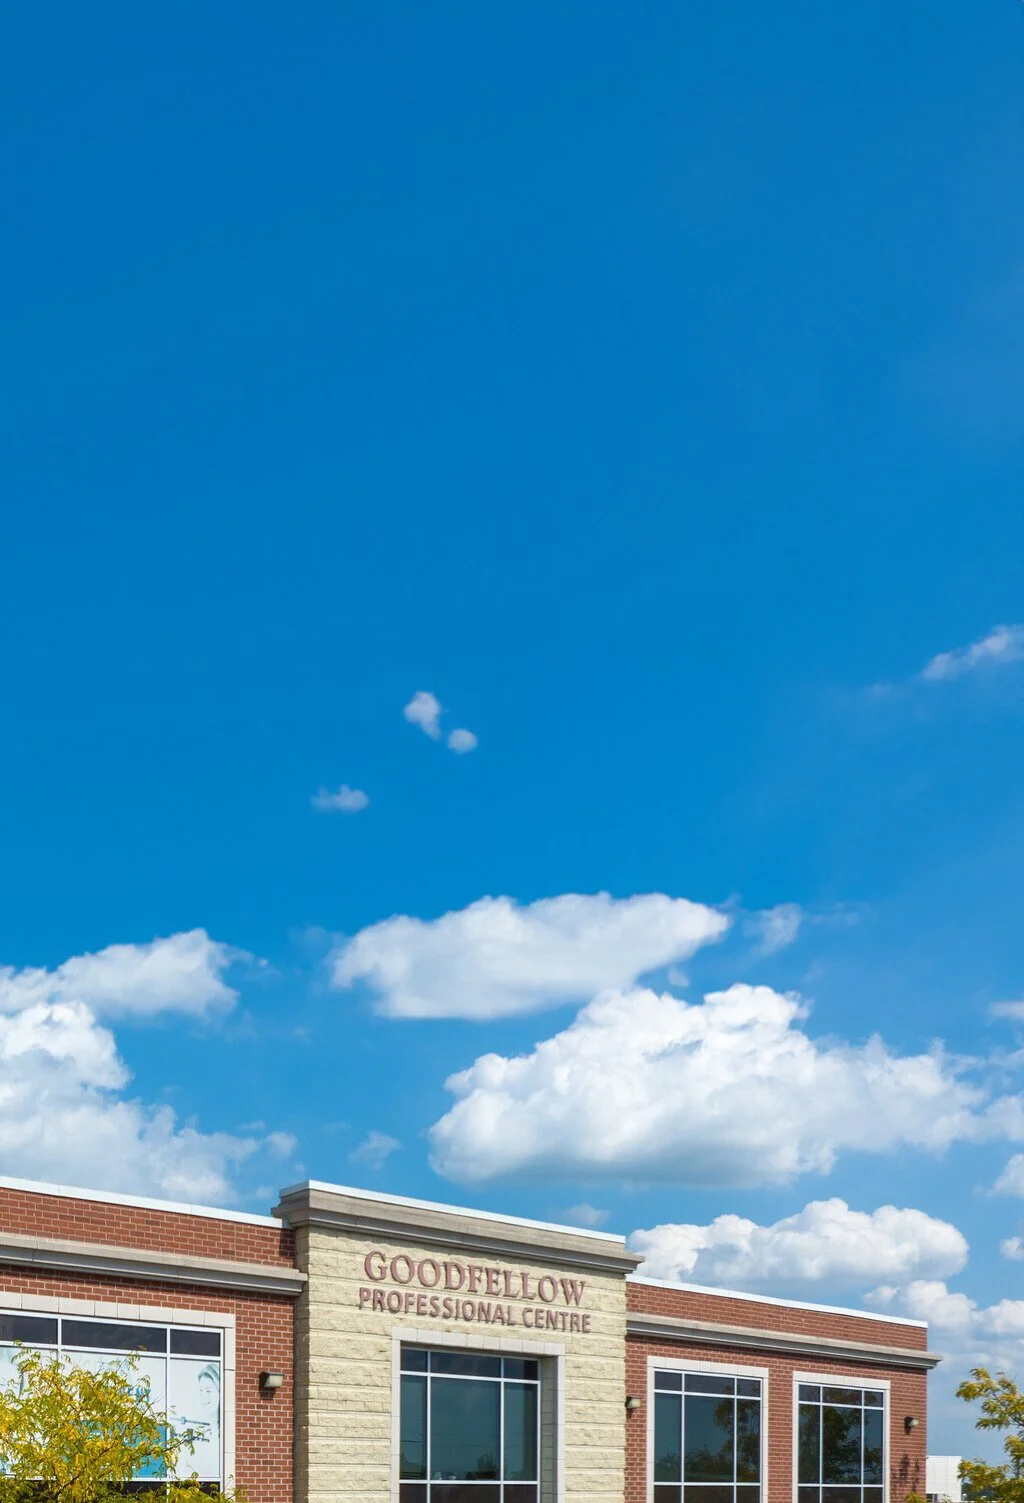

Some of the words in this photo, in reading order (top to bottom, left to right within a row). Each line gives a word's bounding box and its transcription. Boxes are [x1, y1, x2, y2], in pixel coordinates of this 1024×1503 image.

[364, 1250, 587, 1306] GOODFELLOW
[359, 1287, 517, 1327] PROFESSIONAL
[522, 1307, 591, 1333] CENTRE
